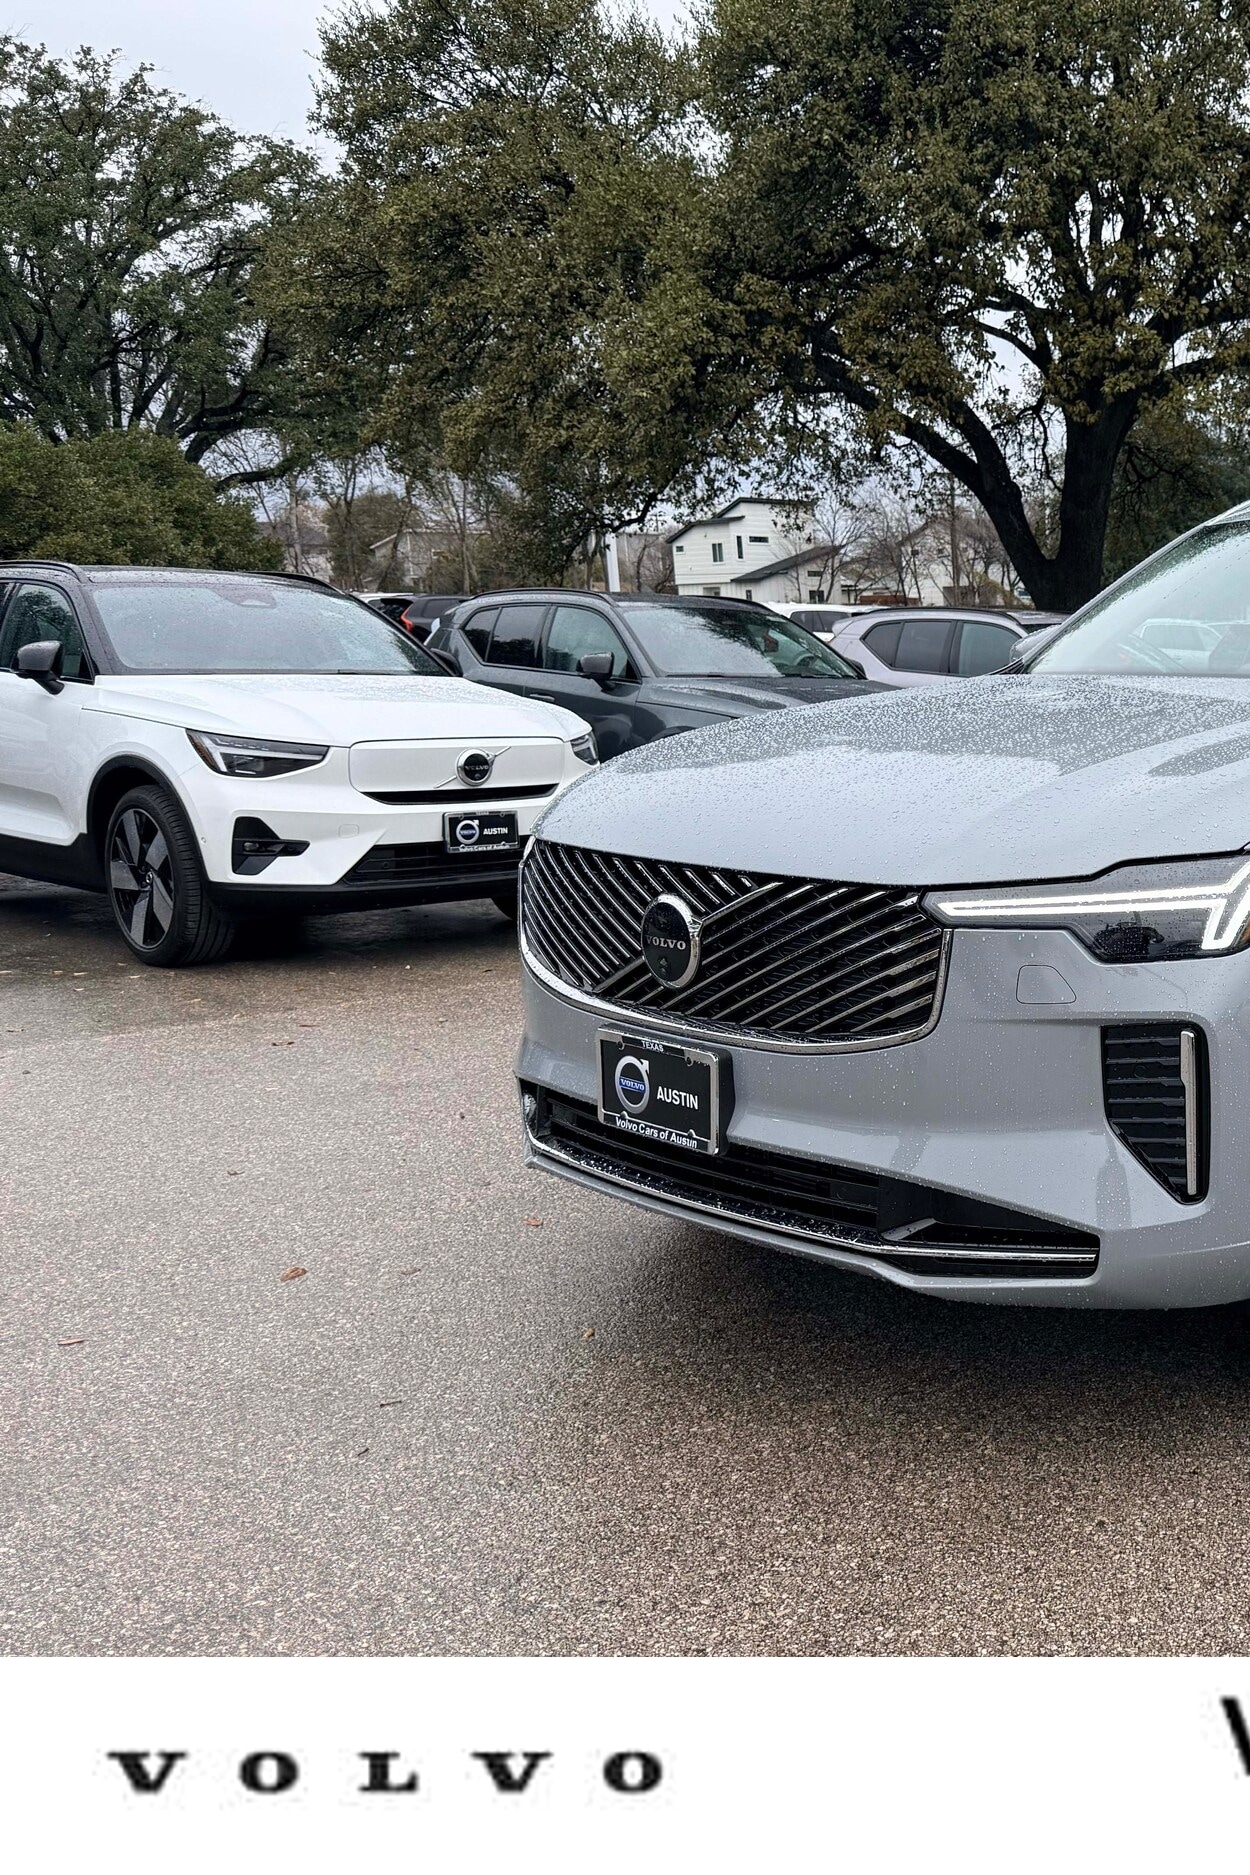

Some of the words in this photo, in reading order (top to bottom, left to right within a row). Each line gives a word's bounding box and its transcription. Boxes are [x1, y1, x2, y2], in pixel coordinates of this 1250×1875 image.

[483, 827, 508, 835] AUSTIN
[645, 935, 686, 950] VOLVO
[641, 1040, 664, 1052] TEXAS
[620, 1078, 645, 1091] VOLVO
[656, 1086, 699, 1110] AUSTIN
[615, 1116, 638, 1132] Volvo
[638, 1124, 658, 1138] Cars
[659, 1130, 669, 1140] of
[670, 1132, 698, 1149] Austin
